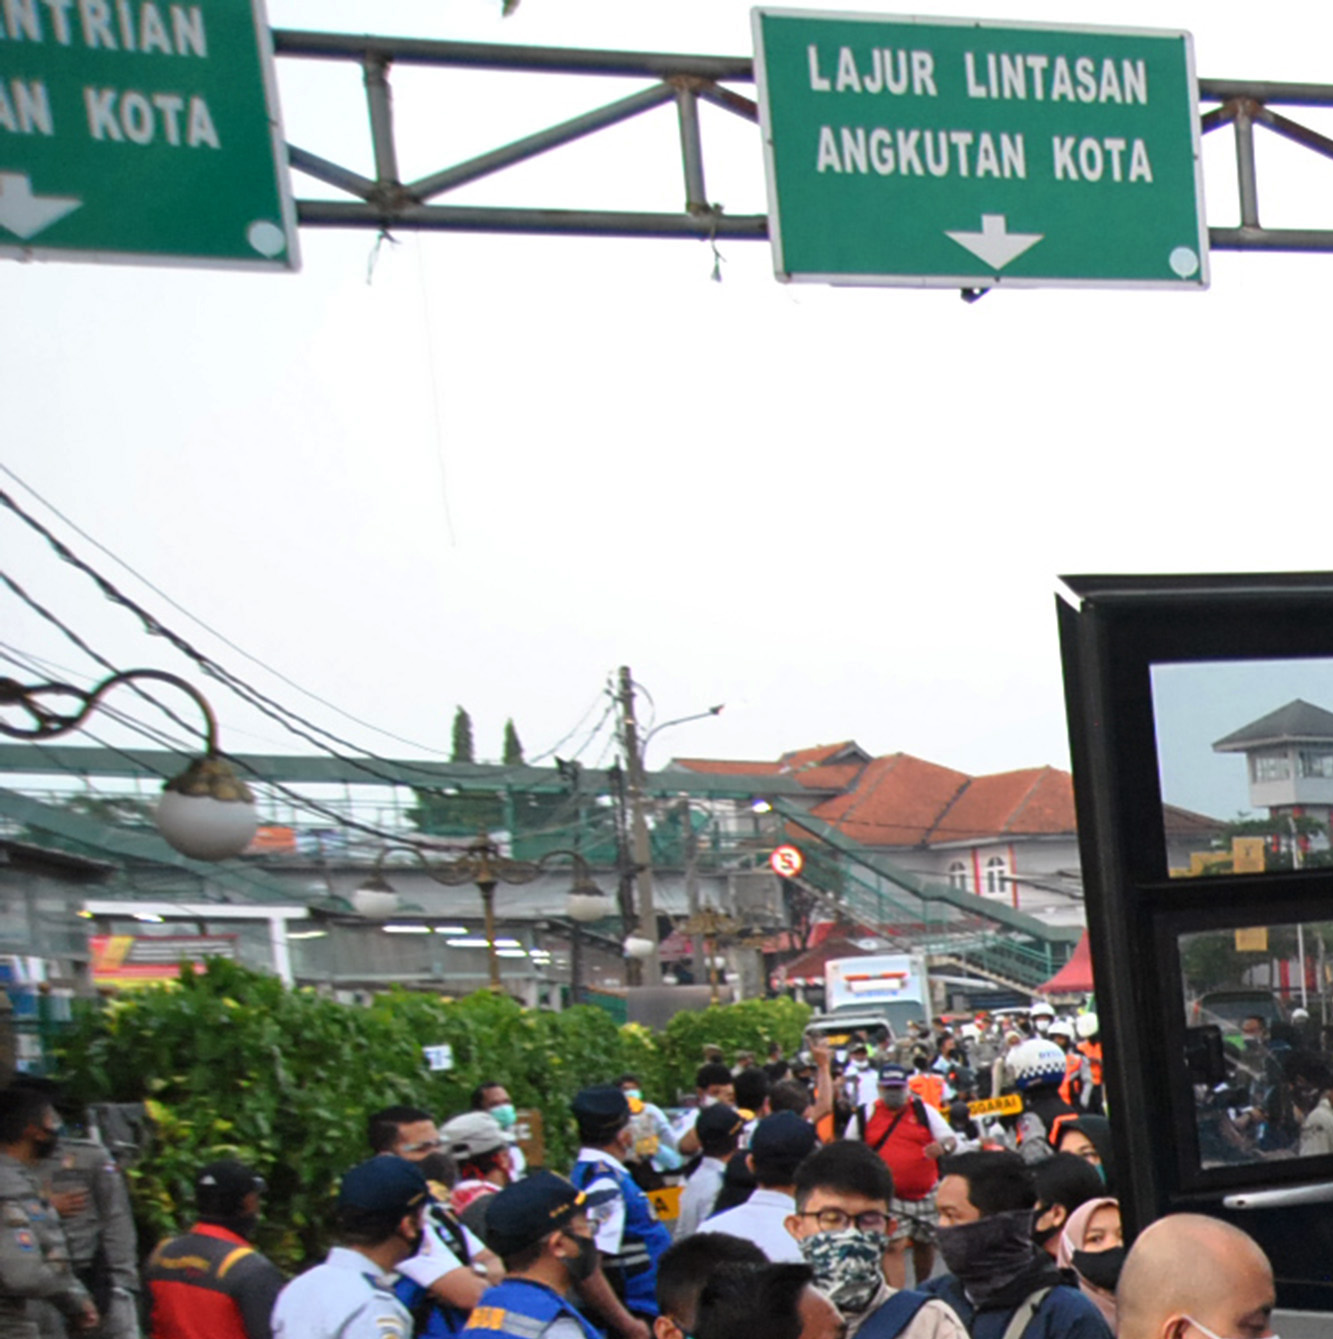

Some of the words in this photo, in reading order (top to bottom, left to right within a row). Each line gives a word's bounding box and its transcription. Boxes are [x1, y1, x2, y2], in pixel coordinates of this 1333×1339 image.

[0, 0, 207, 57] NTRIAN
[807, 44, 938, 97] LAJUR
[963, 51, 1149, 105] LINTASAN
[82, 85, 222, 149] KOTA
[815, 125, 1028, 180] ANGKUTAN
[1051, 135, 1154, 184] KOTA
